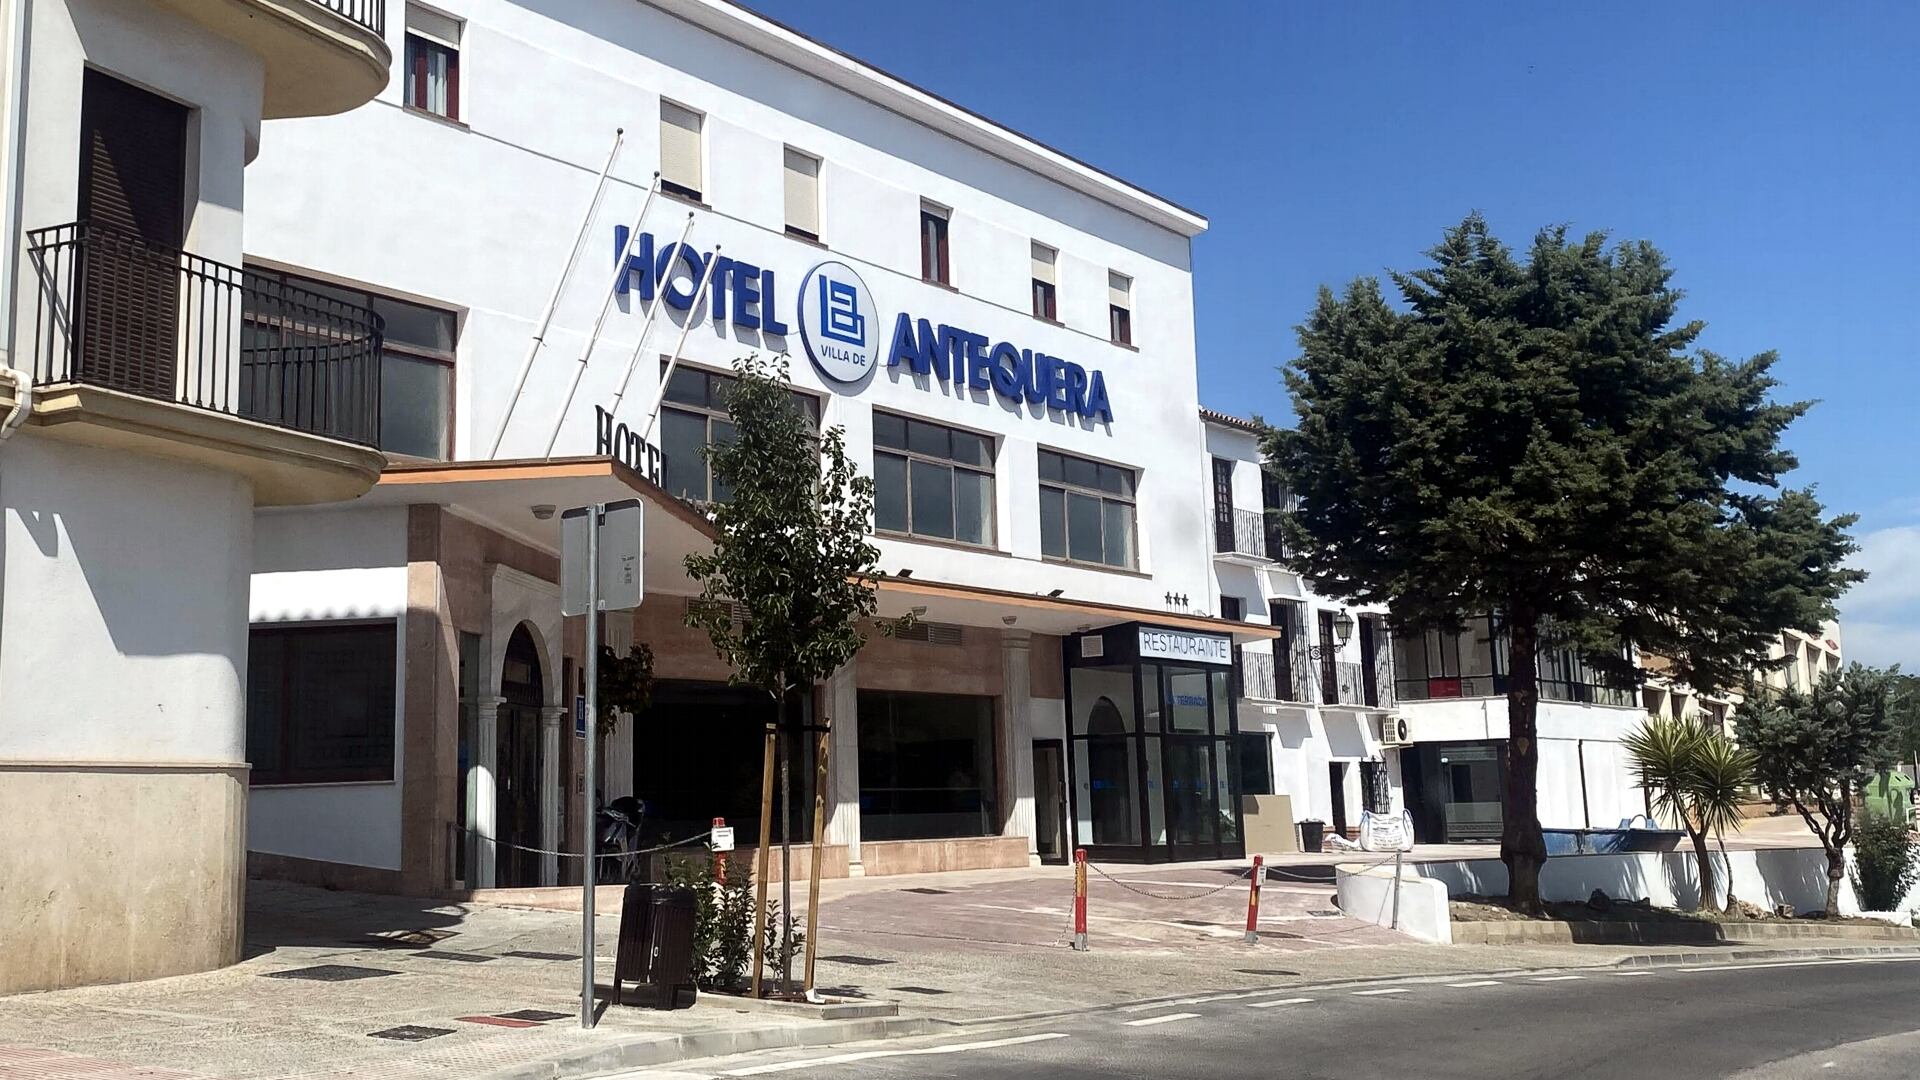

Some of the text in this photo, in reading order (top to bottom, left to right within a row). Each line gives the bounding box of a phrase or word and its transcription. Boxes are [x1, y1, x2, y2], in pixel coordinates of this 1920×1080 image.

[614, 224, 788, 336] HOTEL
[821, 344, 866, 366] VILLA DE
[887, 312, 1114, 423] ANTEQUERA
[1143, 632, 1227, 658] RESTAURANTE
